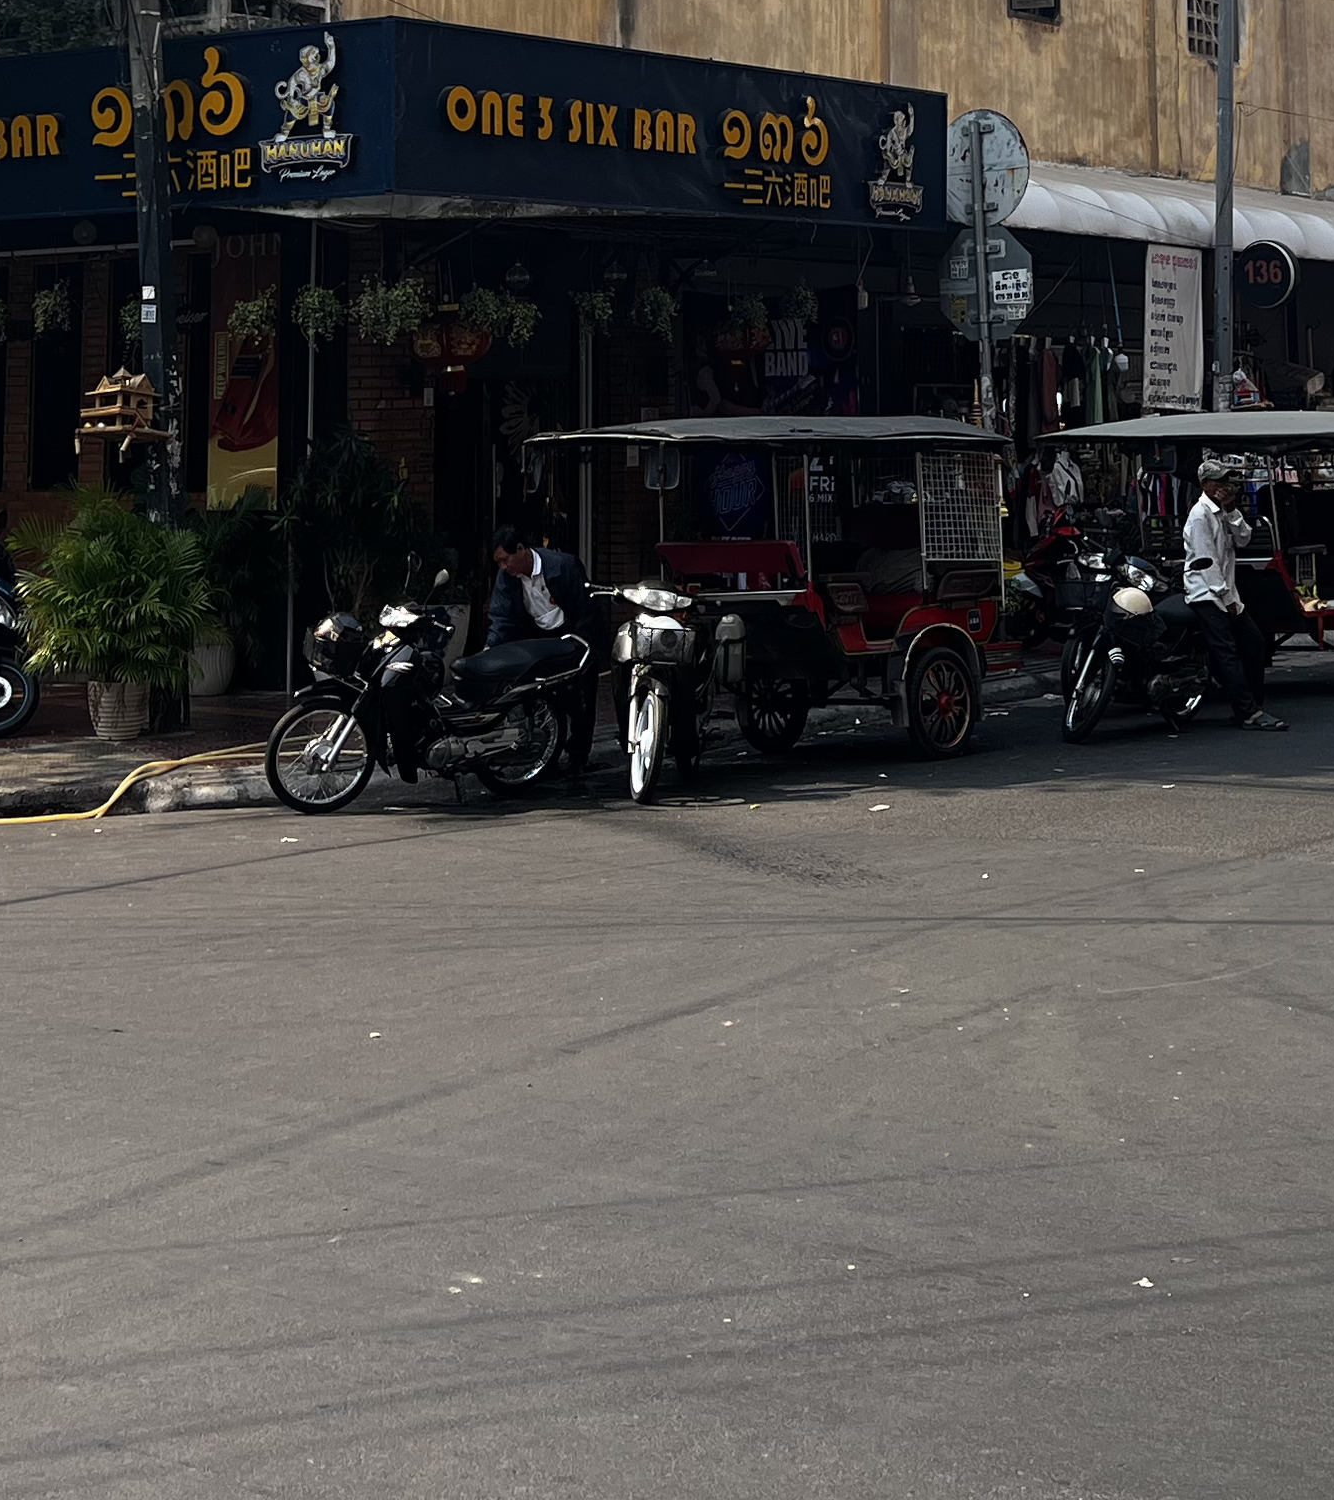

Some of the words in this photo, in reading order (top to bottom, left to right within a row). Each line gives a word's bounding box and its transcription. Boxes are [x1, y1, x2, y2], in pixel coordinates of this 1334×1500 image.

[446, 84, 524, 138] ONE
[536, 95, 555, 141] 3
[568, 99, 619, 148] SIX
[633, 107, 698, 155] BAR
[723, 96, 830, 167] ១៣៦
[265, 139, 346, 162] HANUMAN
[723, 168, 833, 210] 一三六酒吧
[1244, 259, 1284, 285] 136
[764, 350, 809, 377] BAND
